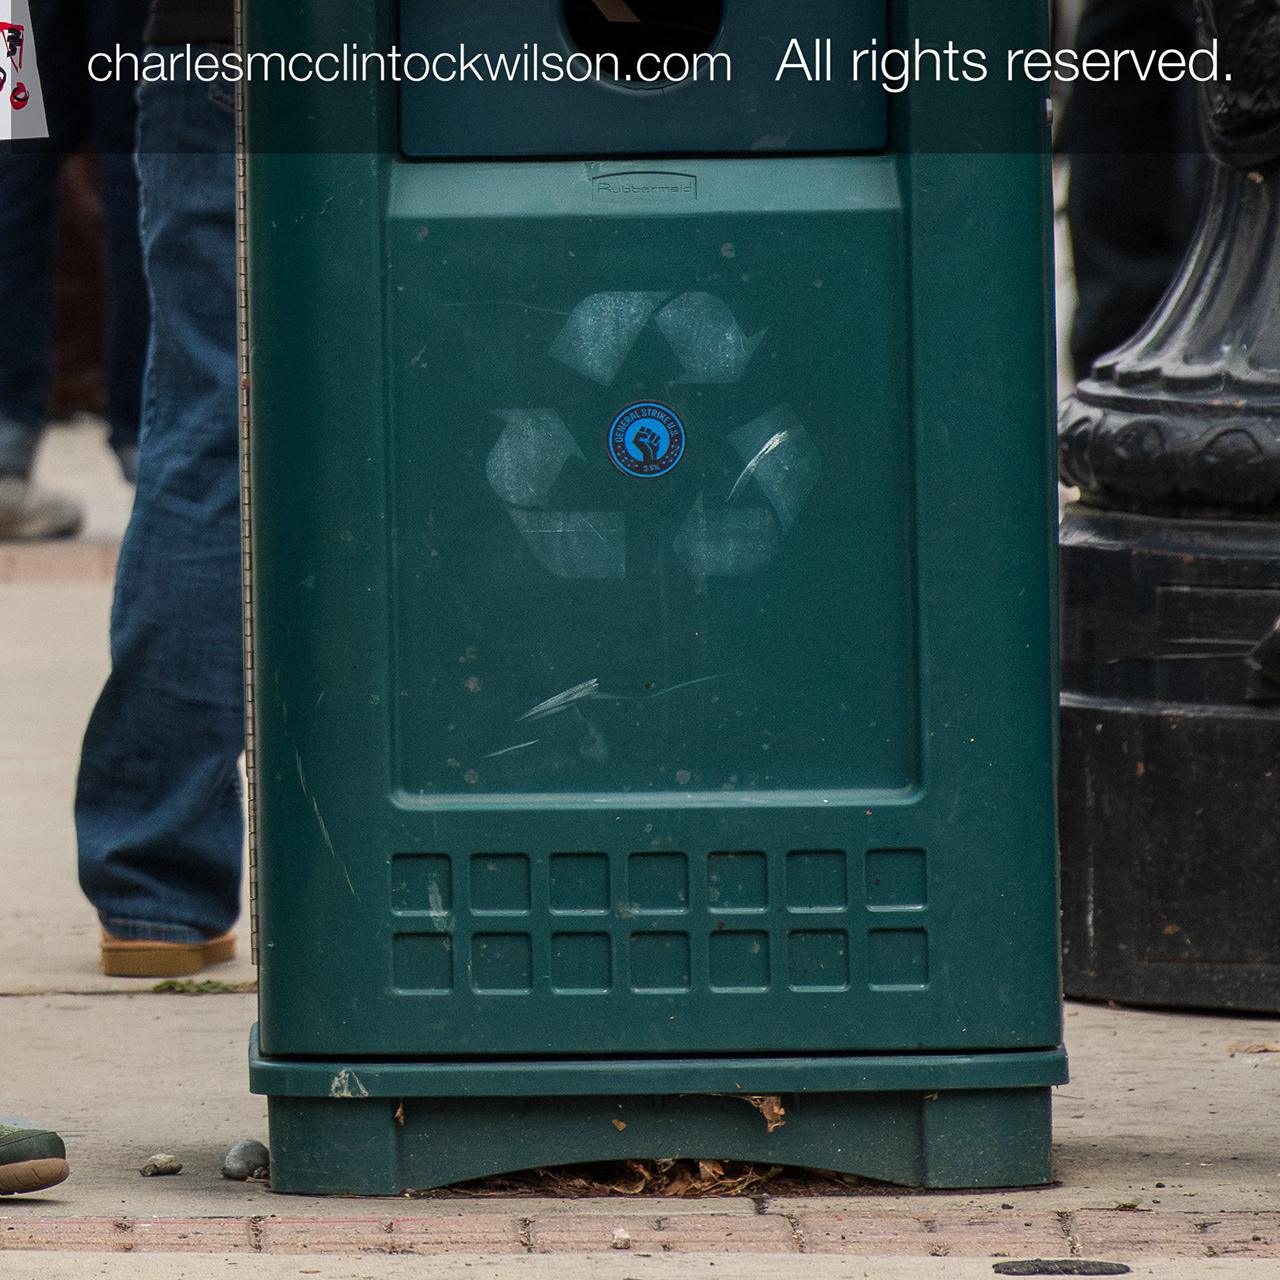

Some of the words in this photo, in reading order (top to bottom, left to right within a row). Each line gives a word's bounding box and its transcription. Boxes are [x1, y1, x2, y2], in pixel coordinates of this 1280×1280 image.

[596, 182, 693, 195] Rubbermaid
[614, 410, 641, 443] GENERAL
[640, 408, 671, 424] STRIKE
